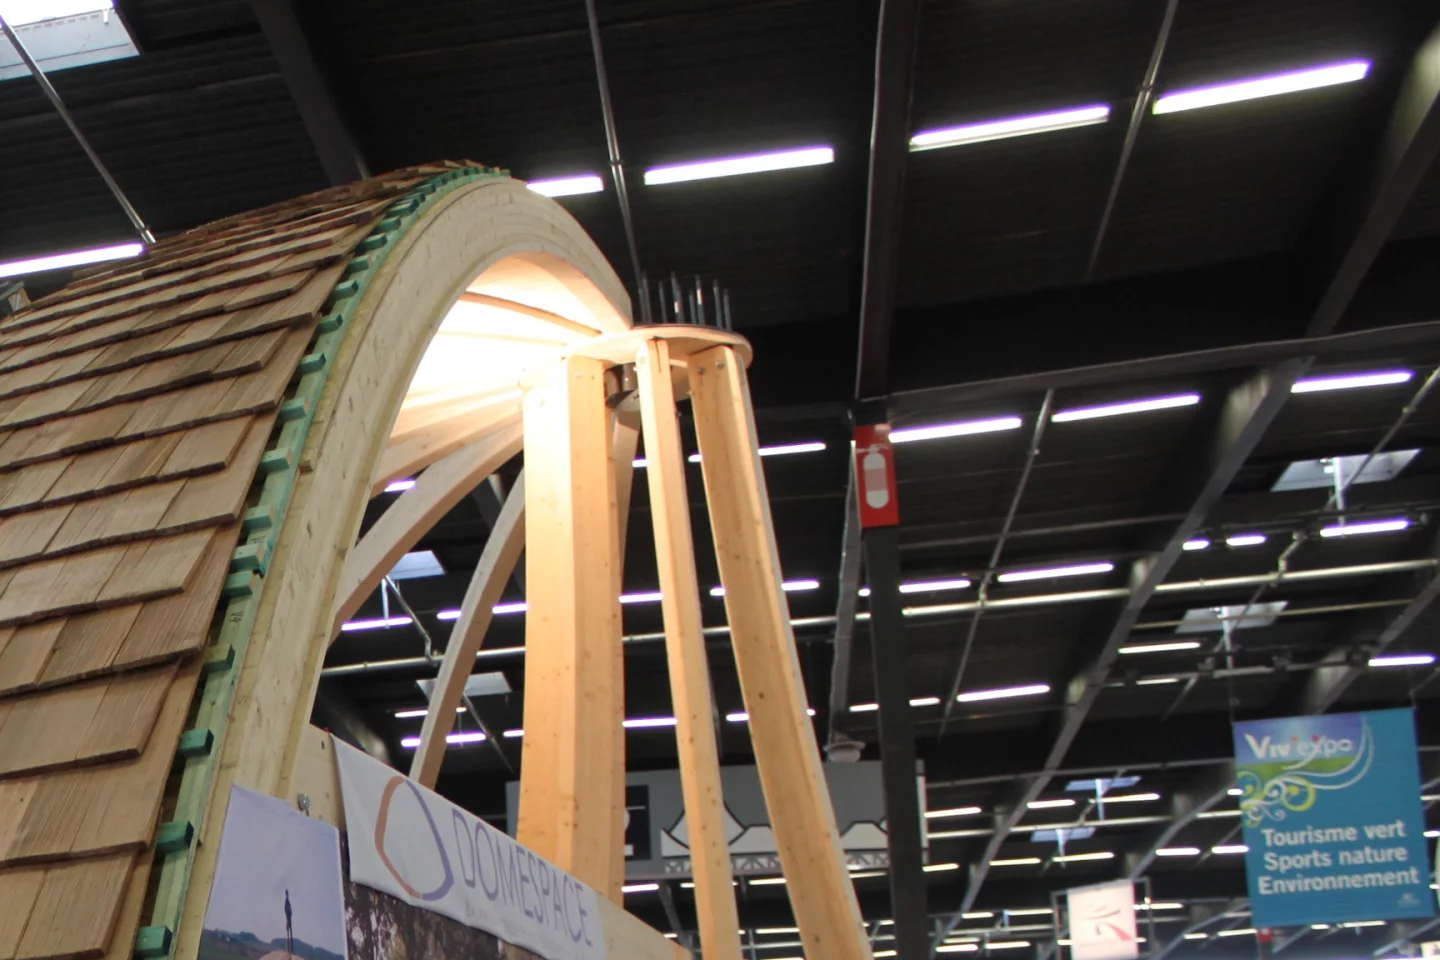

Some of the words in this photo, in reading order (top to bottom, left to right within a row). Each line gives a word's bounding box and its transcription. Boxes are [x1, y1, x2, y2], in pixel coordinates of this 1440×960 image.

[1262, 825, 1357, 846] Tourisme
[1364, 820, 1405, 839] vert
[1264, 849, 1332, 873] Sports
[1339, 846, 1408, 866] nature
[451, 807, 593, 948] DOMESPACE
[1258, 866, 1420, 895] Environnement
